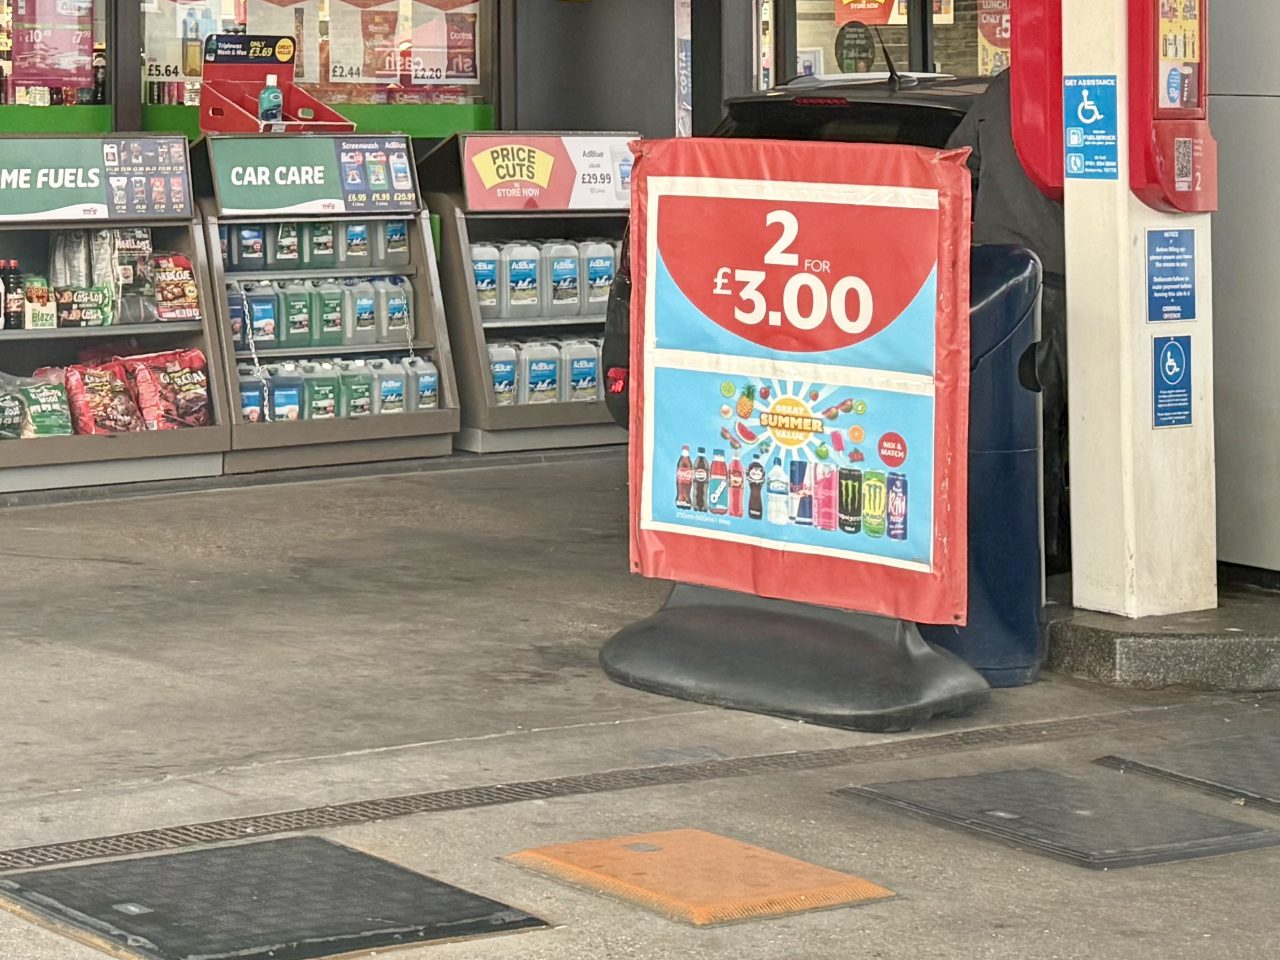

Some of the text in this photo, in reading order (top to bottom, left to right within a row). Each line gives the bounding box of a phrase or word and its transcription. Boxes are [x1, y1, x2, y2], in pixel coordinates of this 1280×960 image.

[982, 0, 1008, 10] LUNCH
[982, 14, 1000, 23] ONLY
[450, 31, 473, 40] Doritos
[249, 47, 273, 57] £3.69
[147, 64, 179, 77] £5.64
[332, 65, 360, 78] £2.44
[414, 68, 442, 80] £2.20
[679, 51, 687, 94] COSTA
[490, 147, 536, 165] PRICE
[582, 150, 604, 158] AdBlue
[231, 166, 324, 185] CAR CARE
[495, 163, 535, 180] CUTS
[37, 168, 100, 188] FUELS
[581, 173, 612, 184] £29.99
[1195, 172, 1201, 190] 2
[372, 193, 390, 201] £9.99
[497, 188, 539, 197] STORE NOW
[764, 210, 799, 267] 2
[511, 261, 536, 270] AdBlue
[590, 259, 611, 268] AdBlue
[804, 259, 831, 273] FOR
[712, 268, 873, 334] £3.00
[32, 311, 54, 322] Blaze
[531, 362, 555, 370] AdBlue
[775, 404, 805, 414] GREAT
[760, 413, 824, 433] SUMMER
[775, 430, 805, 441] VALUE
[882, 441, 902, 450] MIX &
[881, 448, 904, 458] MATCH
